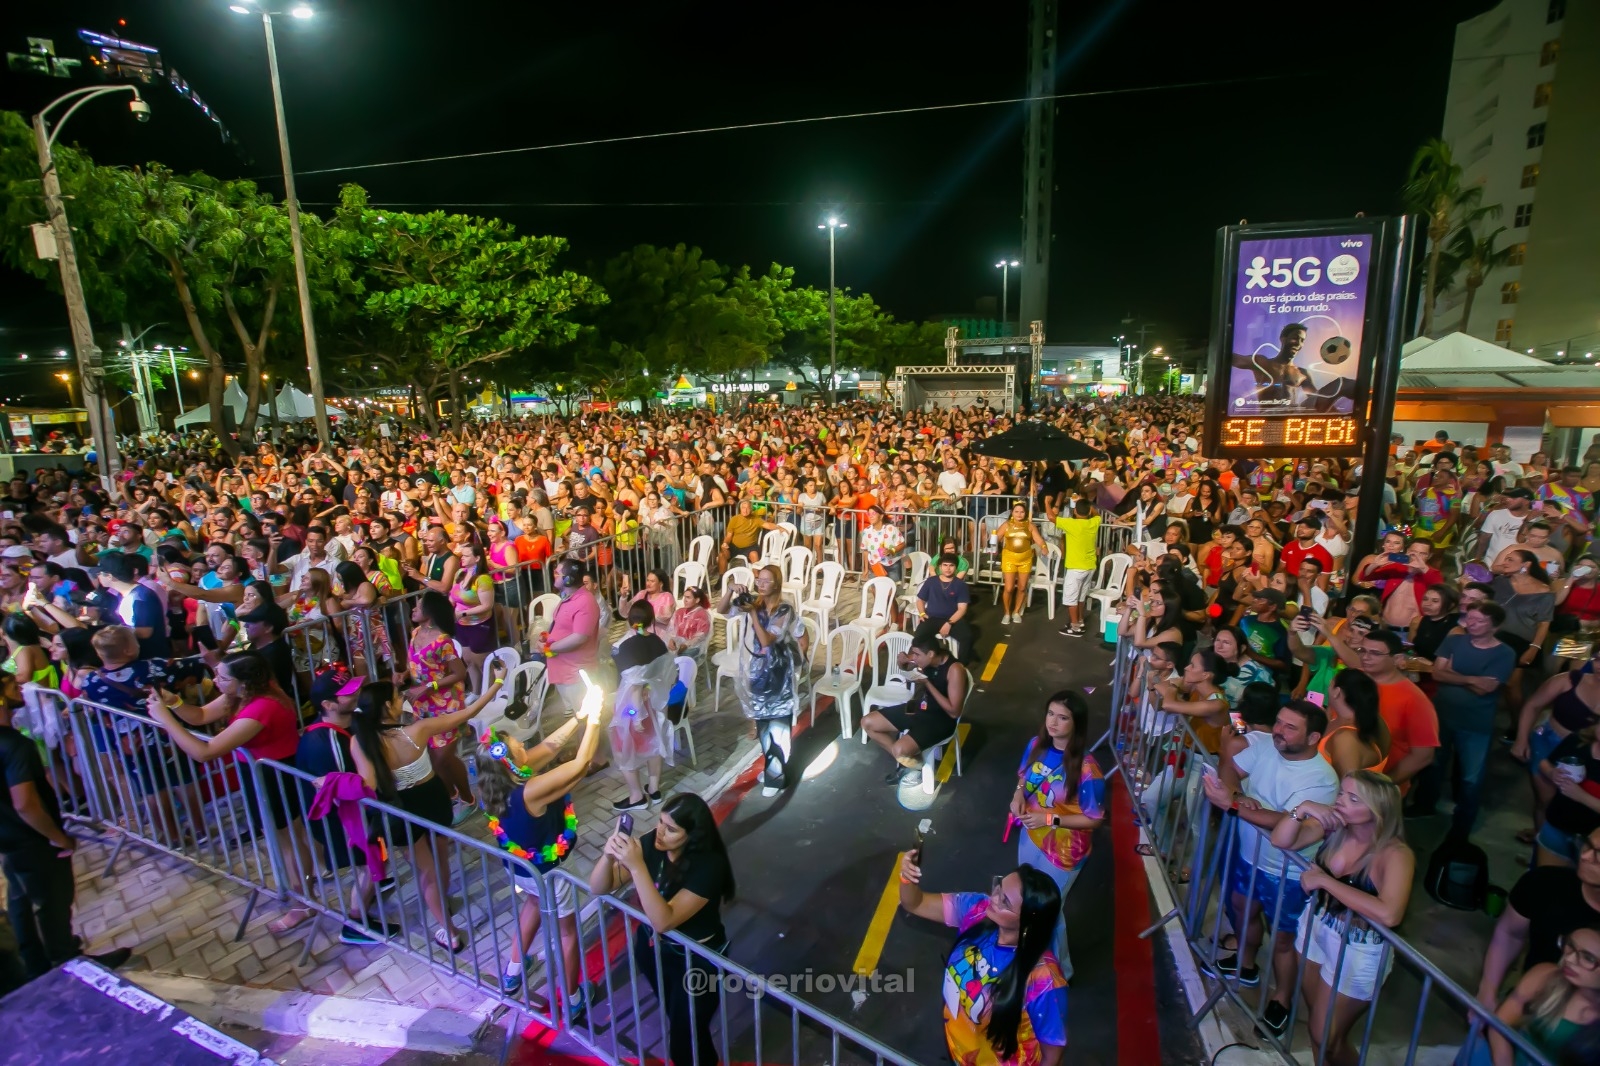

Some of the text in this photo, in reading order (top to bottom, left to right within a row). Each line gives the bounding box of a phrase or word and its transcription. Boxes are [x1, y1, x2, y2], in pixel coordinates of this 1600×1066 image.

[1341, 239, 1363, 248] vivo
[1270, 256, 1321, 288] 5G
[1242, 290, 1358, 304] O mais rápido das praias.
[1268, 302, 1331, 314] E do mundo.
[1225, 419, 1265, 445] SE
